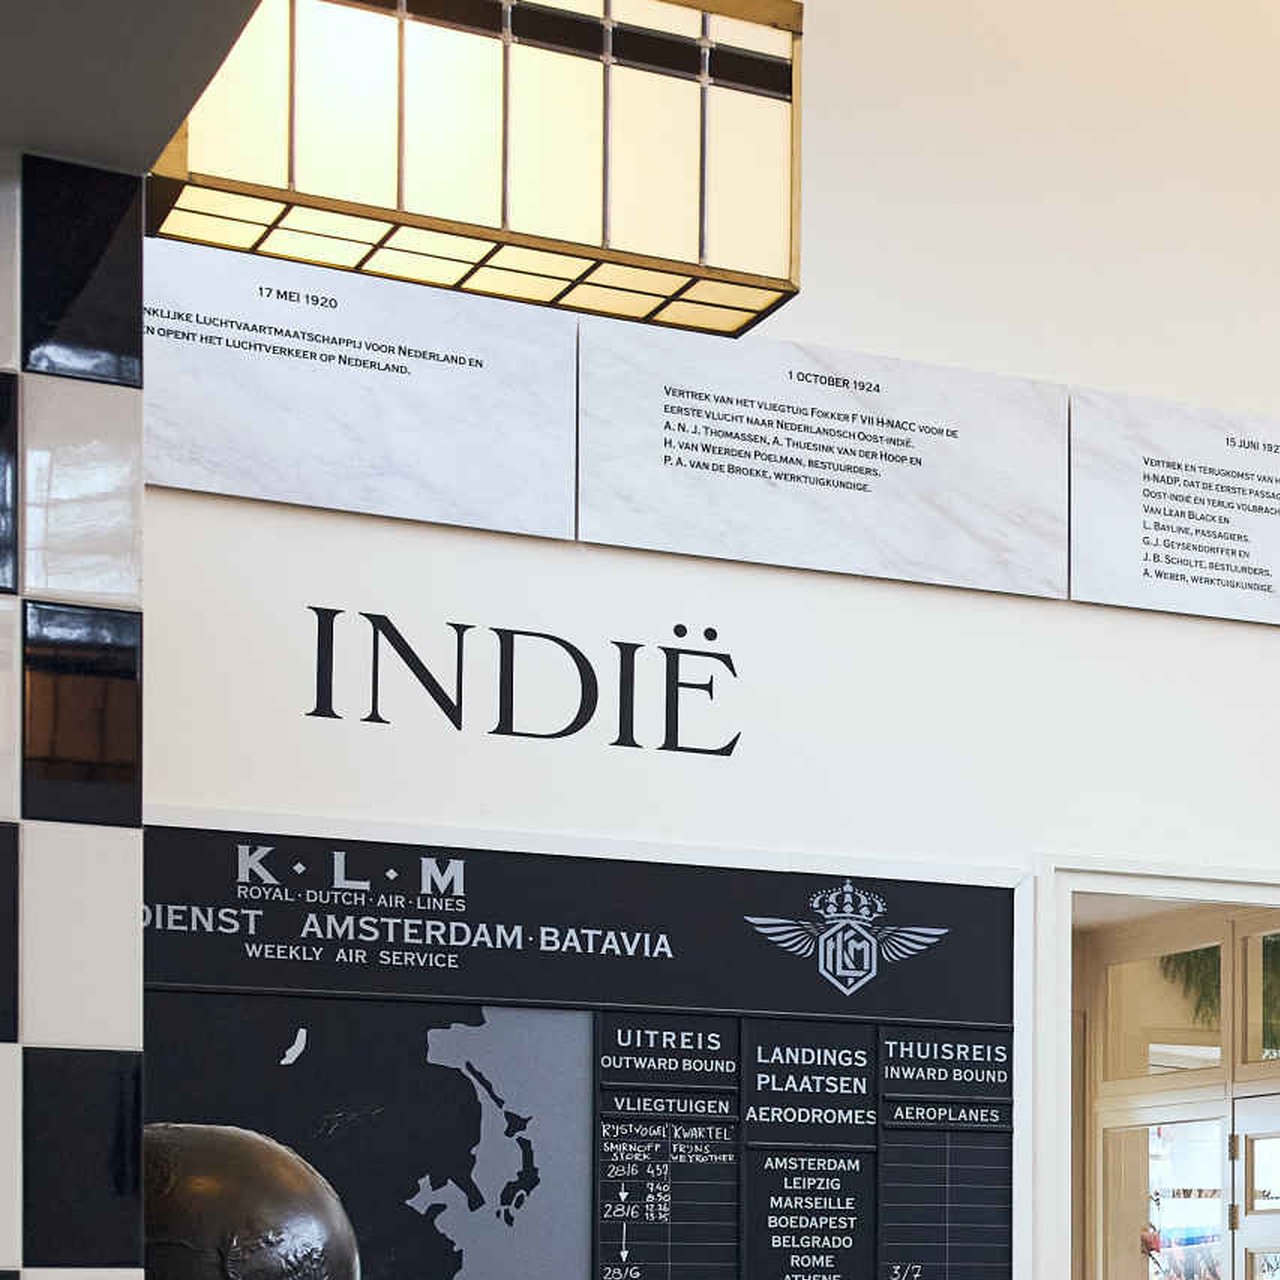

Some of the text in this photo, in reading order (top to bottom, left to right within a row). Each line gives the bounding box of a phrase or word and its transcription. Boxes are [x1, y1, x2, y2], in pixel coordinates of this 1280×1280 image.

[258, 286, 339, 309] 17 MEI 1920
[363, 340, 396, 355] VOOR
[397, 344, 467, 366] NEDERLAND
[467, 357, 483, 369] EN
[787, 370, 881, 394] 1 OCTOBER 1924
[663, 385, 711, 402] VERTREK
[712, 394, 733, 405] VAN
[735, 397, 755, 409] HET
[304, 605, 743, 756] INDIË
[244, 942, 459, 969] WEEKLY AIR SERVICE
[616, 1028, 721, 1051] UITREIS
[756, 1045, 867, 1067] LANDINGS
[883, 1040, 1007, 1062] THUISREIS
[600, 1055, 736, 1073] OUTWARD BOUND
[884, 1065, 1008, 1083] INWARD BOUND
[756, 1073, 867, 1094] PLAATSEN
[613, 1096, 729, 1117] VLIEGTUIGEN
[744, 1105, 877, 1125] AERODROMES
[893, 1105, 999, 1123] AEROPLANES
[763, 1156, 860, 1172] AMSTERDAM
[783, 1176, 841, 1190] LEIPZIG
[769, 1195, 855, 1210] MARSEILLE
[767, 1214, 858, 1229] BOEDAPEST
[771, 1234, 853, 1249] BELGRADO
[790, 1254, 835, 1268] ROME
